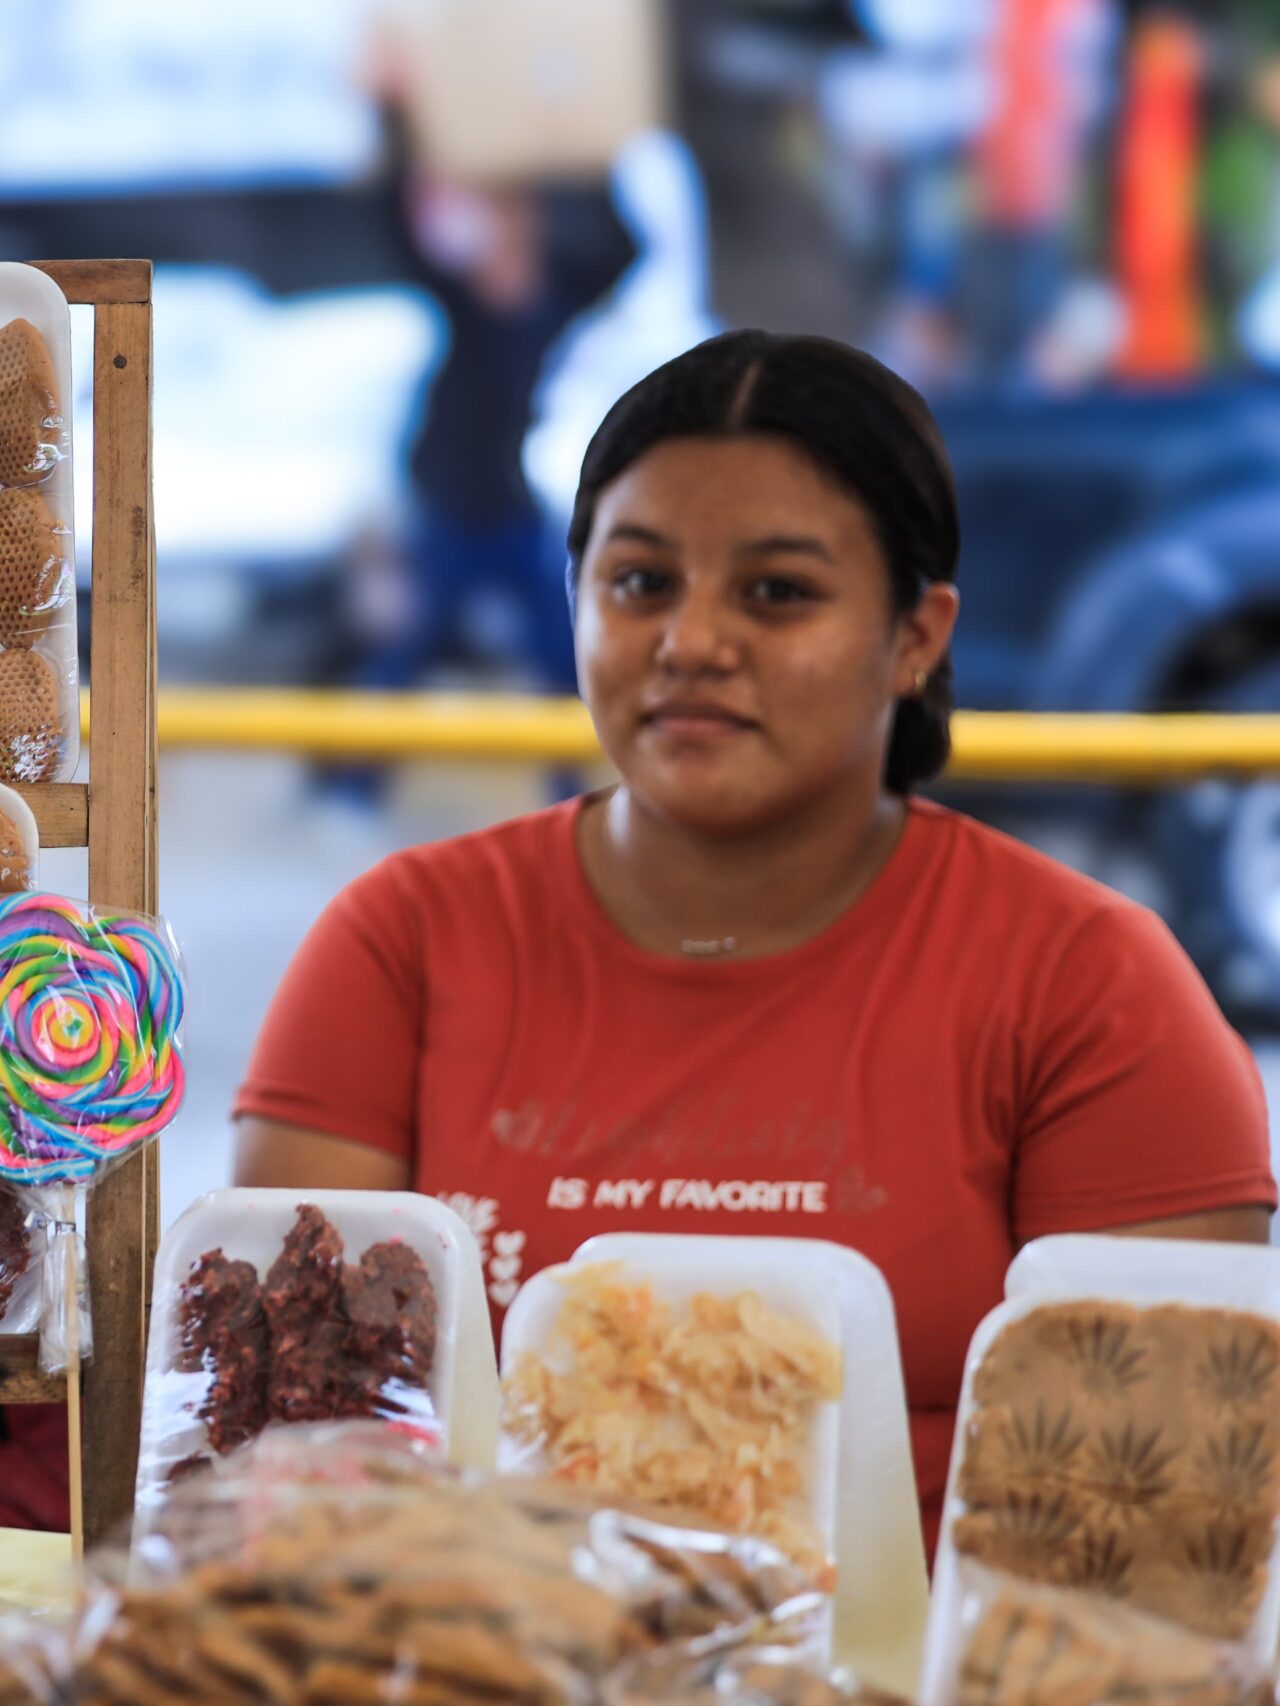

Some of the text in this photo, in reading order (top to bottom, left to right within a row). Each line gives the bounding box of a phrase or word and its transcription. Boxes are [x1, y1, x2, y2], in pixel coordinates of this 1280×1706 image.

[547, 1177, 827, 1213] IS MY FAVORITE
